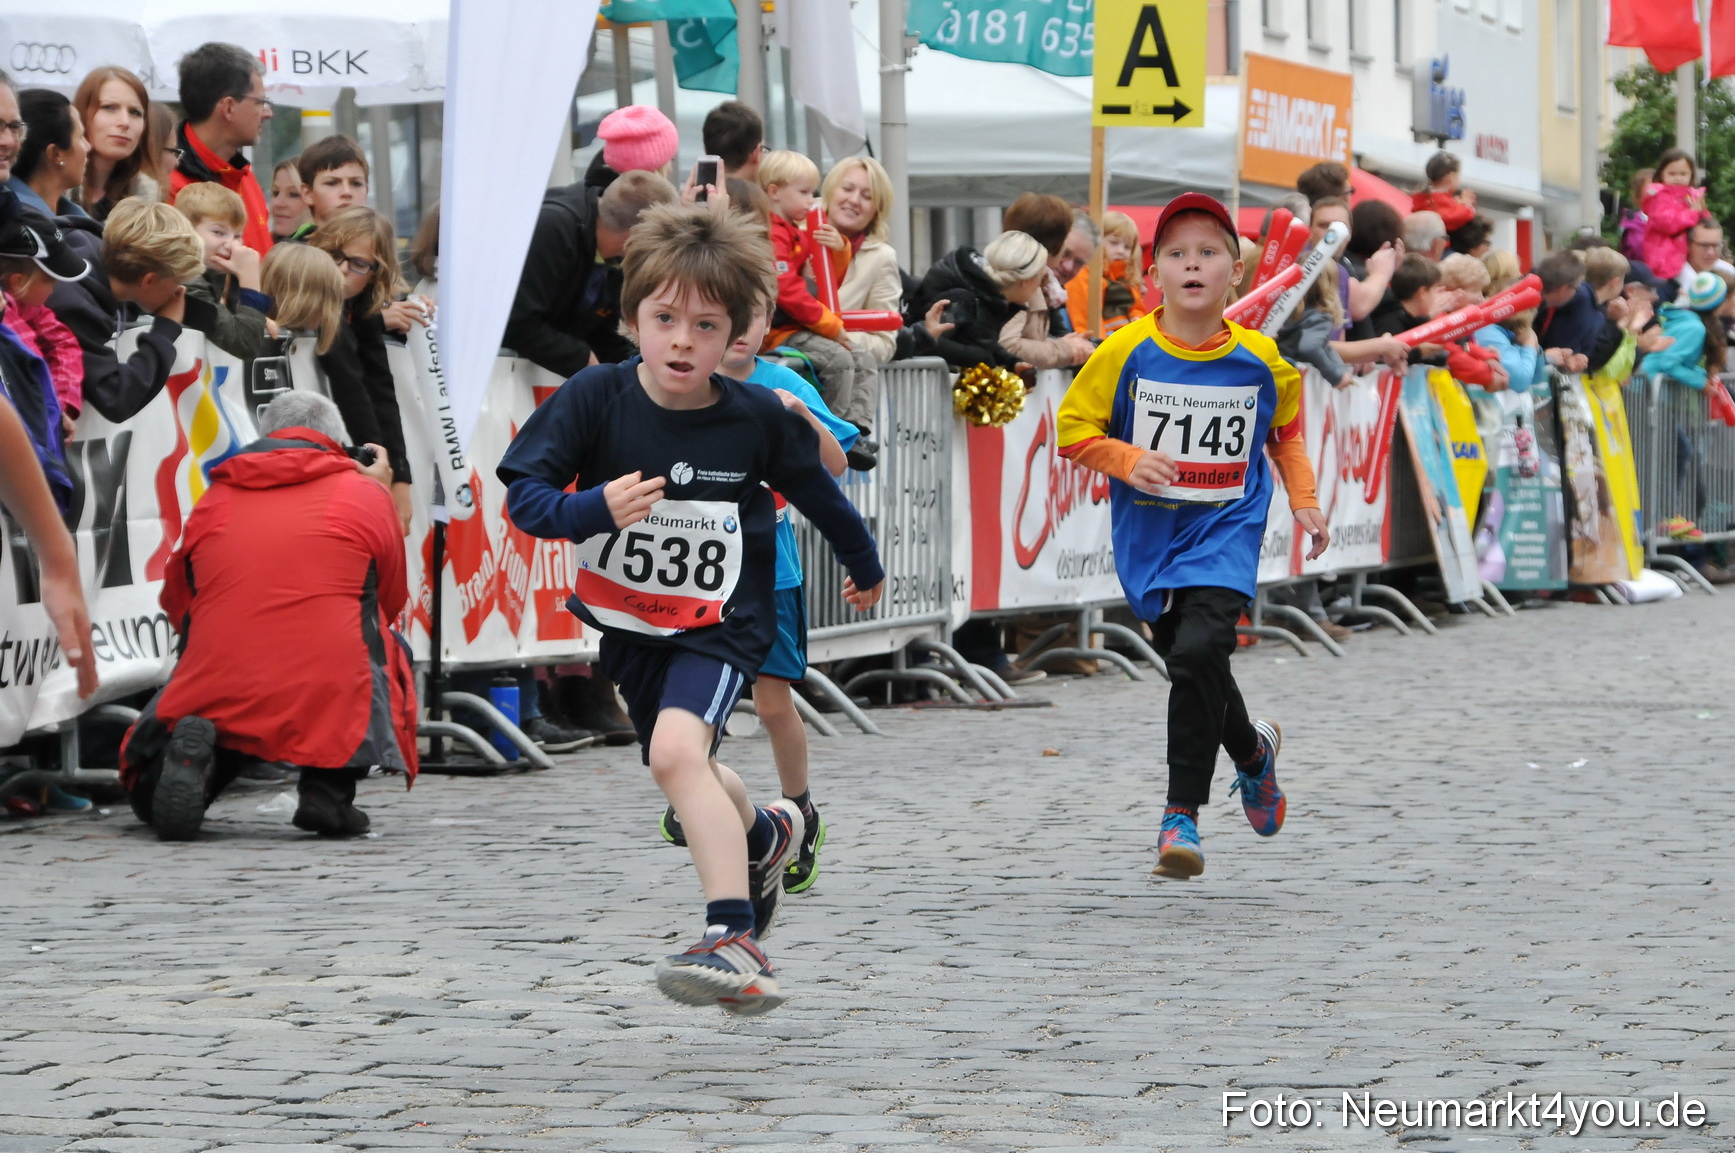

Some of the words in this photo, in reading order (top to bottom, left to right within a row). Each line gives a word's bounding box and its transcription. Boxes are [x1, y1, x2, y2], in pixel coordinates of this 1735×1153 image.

[1116, 3, 1181, 87] A
[291, 48, 369, 75] BKK
[1138, 391, 1180, 407] PARTL
[1182, 396, 1240, 409] Neumarkt
[1147, 410, 1246, 457] 7143
[1176, 468, 1231, 485] xander
[637, 514, 717, 531] Neumarkt
[597, 529, 727, 592] 7538
[623, 595, 679, 616] Cedric
